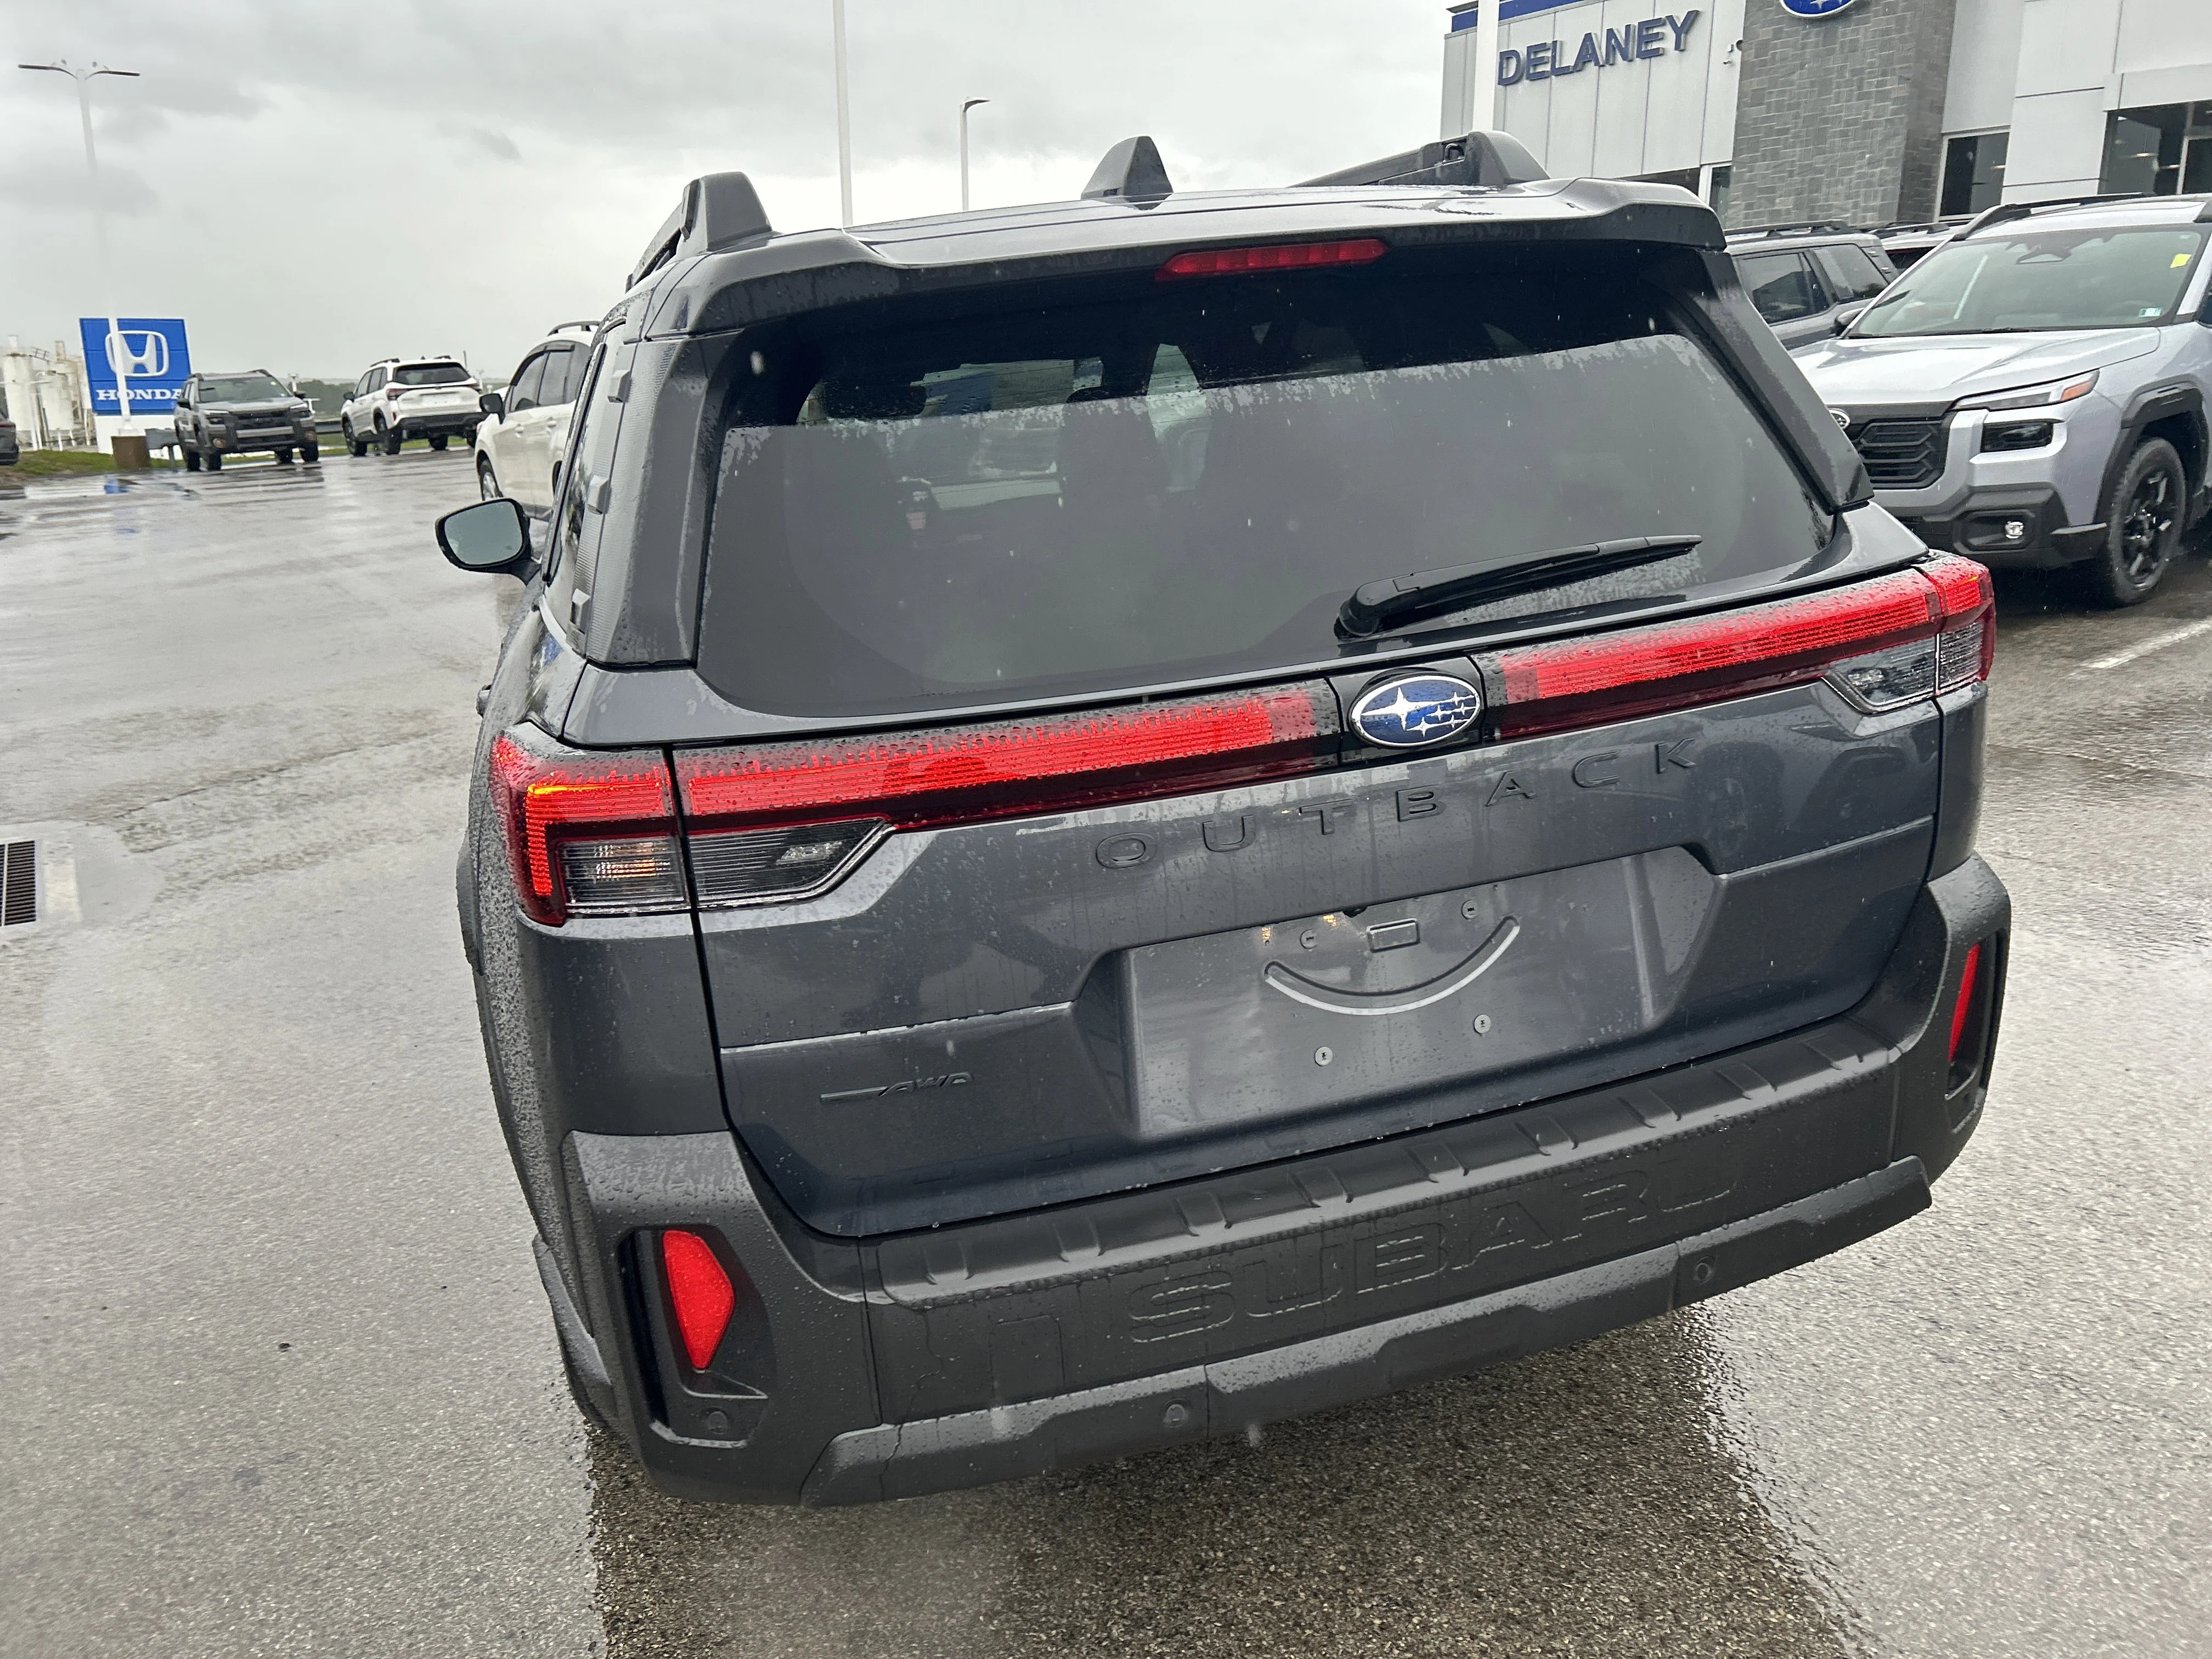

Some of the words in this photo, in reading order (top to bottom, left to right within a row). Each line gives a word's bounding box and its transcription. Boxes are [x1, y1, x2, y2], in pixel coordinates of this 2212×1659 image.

[1498, 10, 1700, 86] DELANEY
[1096, 737, 1697, 869] OUTBACK
[878, 1071, 973, 1097] AWD
[1129, 1147, 1740, 1344] SUBARU
